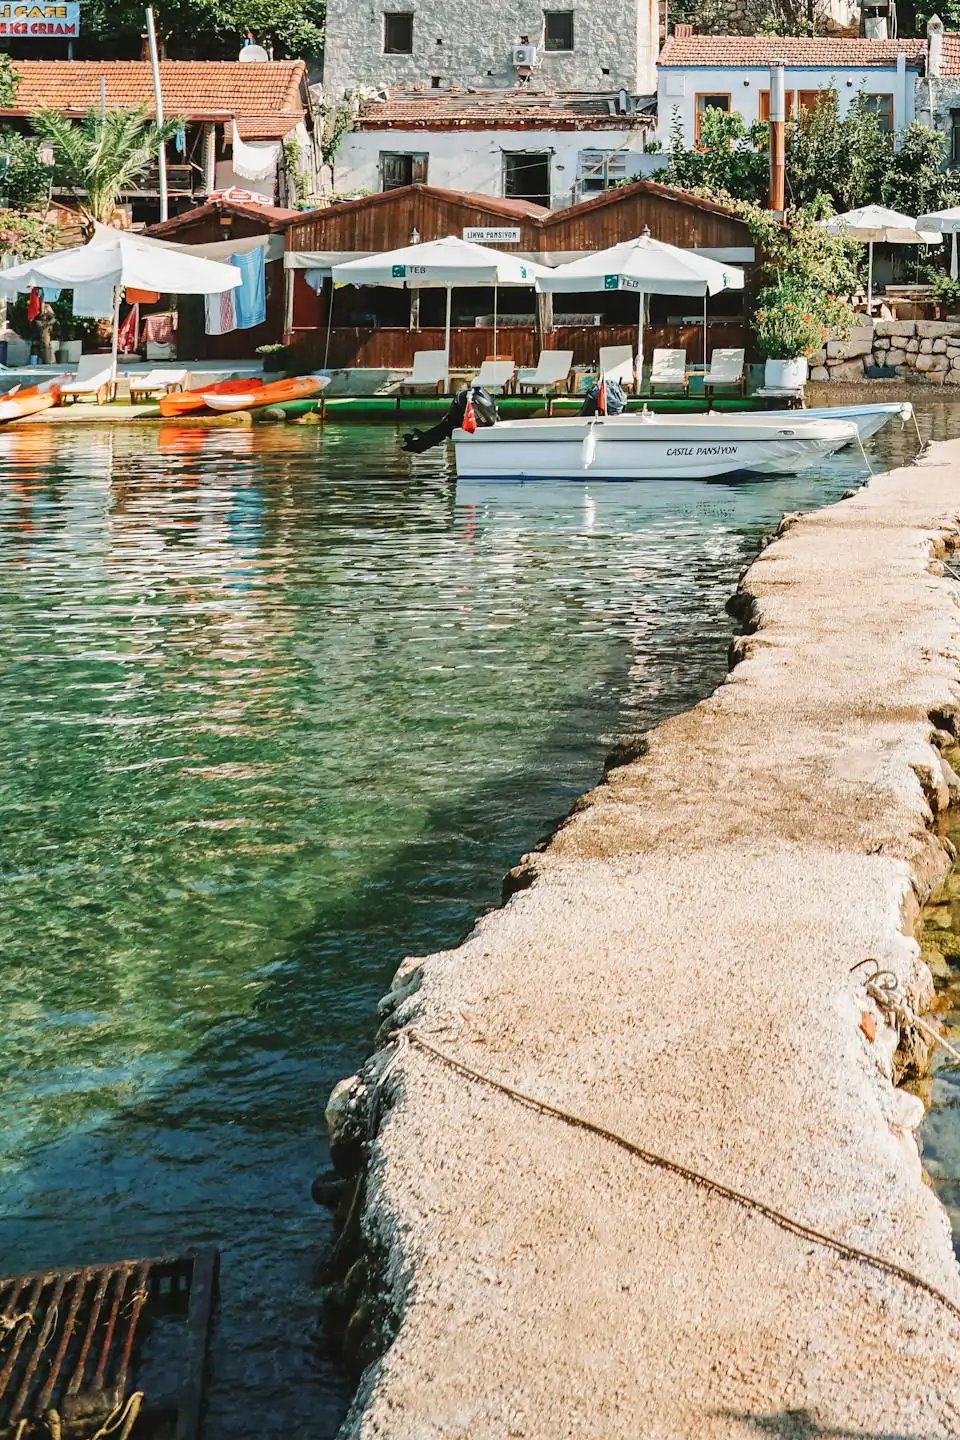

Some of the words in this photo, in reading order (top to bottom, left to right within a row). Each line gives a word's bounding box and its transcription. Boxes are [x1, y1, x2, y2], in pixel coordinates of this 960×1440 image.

[14, 5, 67, 18] CAFE
[9, 23, 28, 35] ICE
[30, 23, 76, 35] CREAM
[408, 266, 426, 275] TEB
[621, 278, 639, 288] TEB
[666, 447, 694, 457] CASTLE
